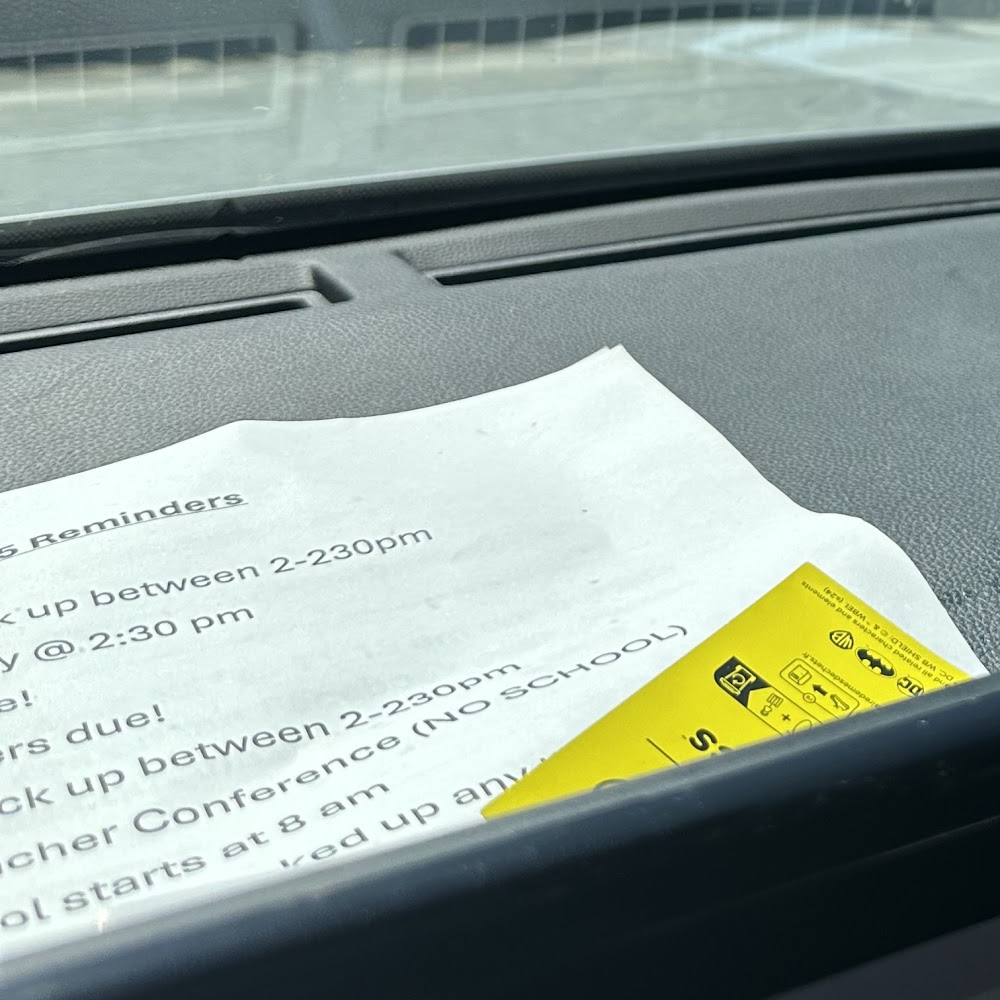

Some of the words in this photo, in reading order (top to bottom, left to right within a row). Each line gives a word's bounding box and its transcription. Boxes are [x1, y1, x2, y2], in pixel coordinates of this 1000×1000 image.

[30, 493, 245, 549] Reminders
[27, 598, 78, 618] up
[90, 565, 260, 607] between
[270, 526, 434, 574] 2-230pm
[800, 580, 836, 608] elements
[34, 640, 75, 661] @
[89, 620, 177, 650] 2:30
[191, 607, 254, 634] pm
[835, 606, 852, 620] and
[852, 619, 893, 650] characters
[893, 648, 923, 671] related
[921, 659, 937, 671] WB
[0, 738, 51, 762] rs
[66, 704, 165, 744] due!
[0, 825, 118, 875] cher
[133, 735, 401, 833] Conference
[411, 699, 491, 738] (NO
[500, 624, 688, 700] SCHOOL)
[66, 769, 126, 797] up
[138, 721, 331, 776] between
[340, 663, 522, 730] 2-230pm
[381, 802, 440, 831] up
[63, 855, 207, 911] starts
[223, 831, 269, 858] at
[278, 814, 306, 833] 8
[320, 782, 390, 817] am
